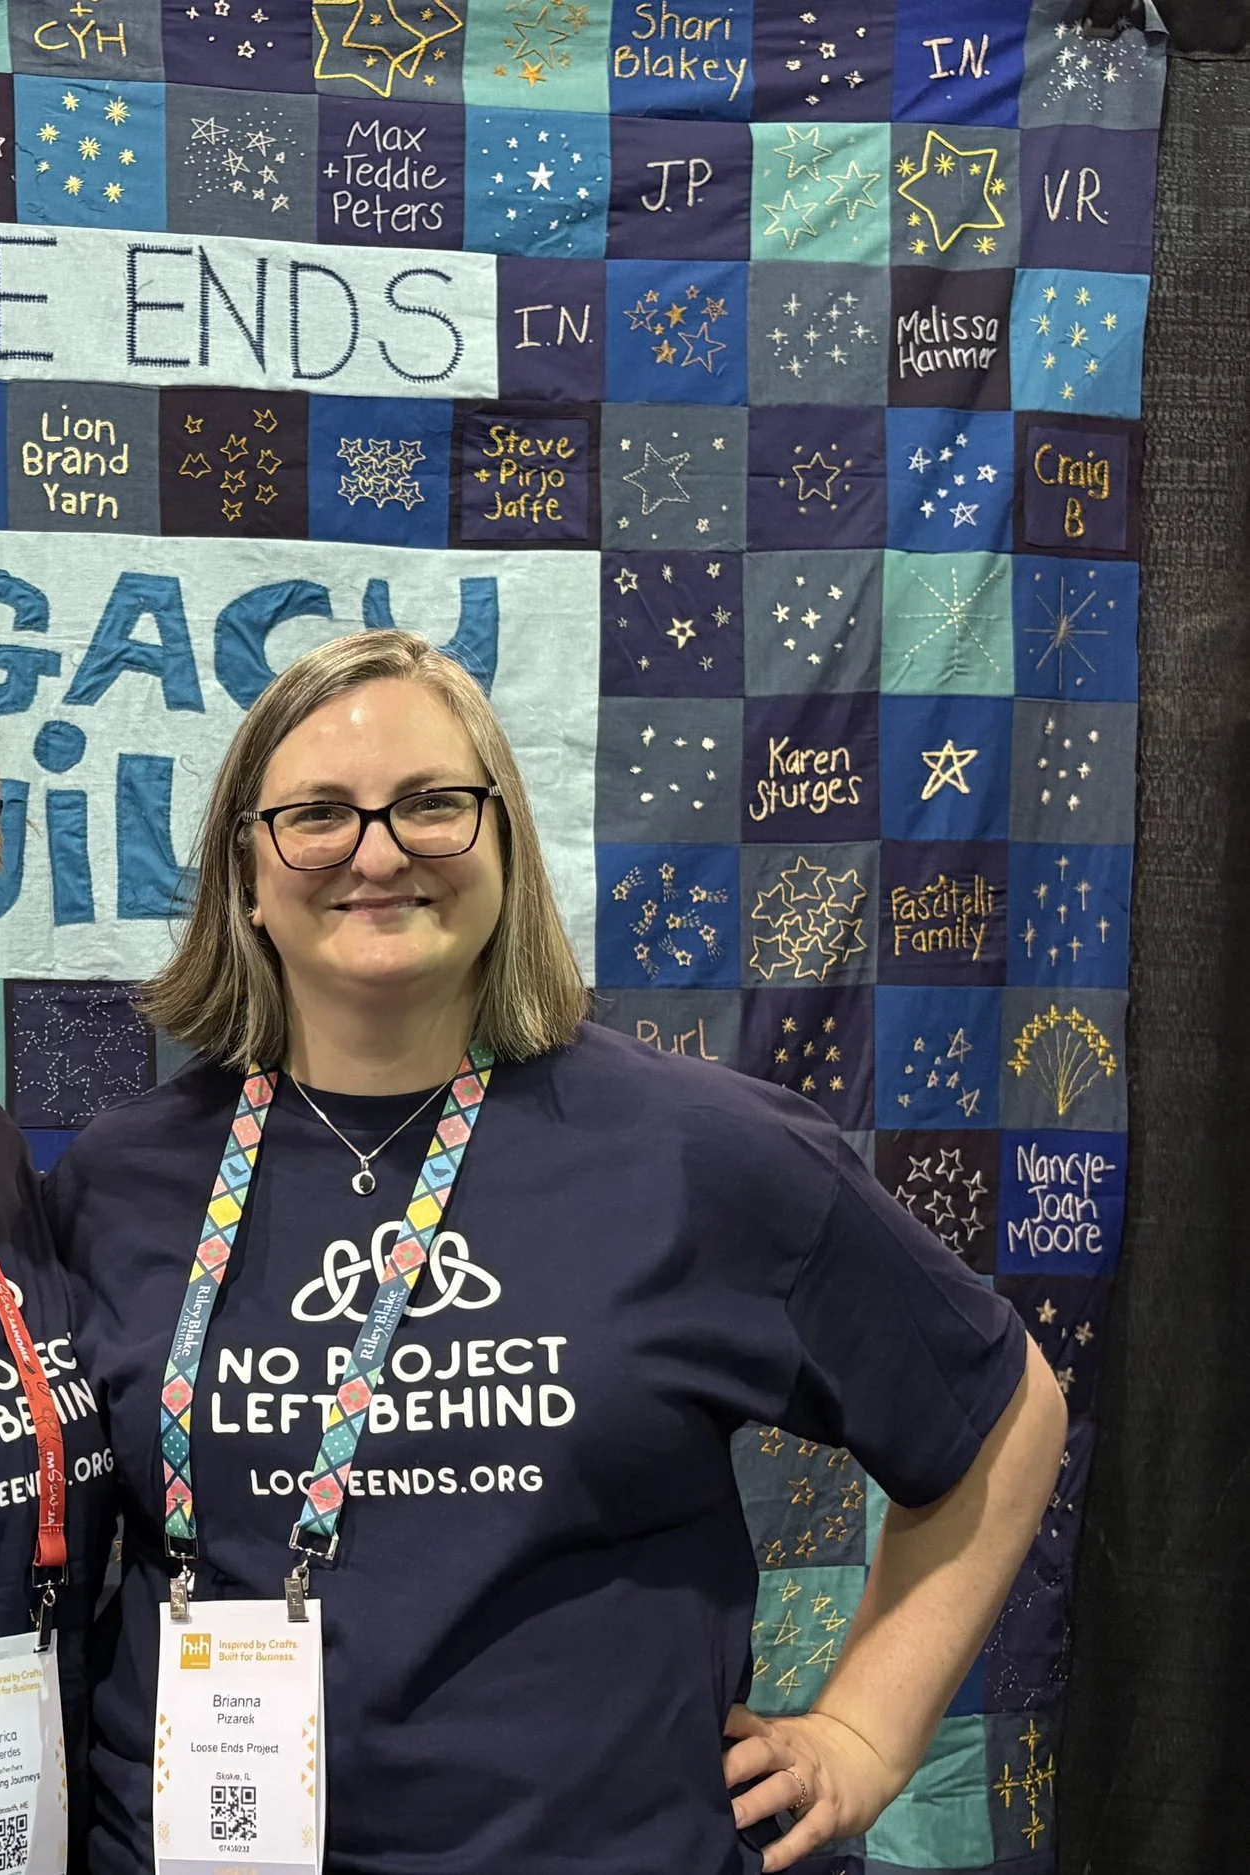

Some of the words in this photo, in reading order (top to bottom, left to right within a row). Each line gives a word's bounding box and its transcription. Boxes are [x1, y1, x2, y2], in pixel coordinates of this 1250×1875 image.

[33, 19, 127, 60] CYH
[635, 2, 731, 42] Shari
[613, 45, 747, 101] Blakey
[922, 35, 991, 79] I.N.
[346, 121, 428, 154] Max
[331, 191, 444, 232] Peters
[1043, 168, 1109, 224] V.R.
[125, 242, 465, 383] ENDS
[513, 304, 593, 349] I.N.
[897, 311, 1000, 345] Melissa
[41, 403, 117, 445] Lion
[483, 425, 575, 459] Steve
[21, 439, 130, 477] Brand
[499, 458, 565, 498] Pirjo
[1034, 443, 1111, 500] Craig
[43, 482, 120, 520] Yarn
[1064, 498, 1085, 538] B
[767, 736, 851, 778] Karen
[748, 772, 862, 822] Sturges
[894, 913, 986, 961] Family
[1016, 1142, 1116, 1189] Nancye-
[1027, 1185, 1097, 1225] Joan
[1008, 1222, 1102, 1258] Moore
[186, 1285, 211, 1318] Riley
[7, 1315, 31, 1362] JANOME
[182, 1320, 202, 1356] Blake
[360, 1324, 388, 1360] Riley
[374, 1290, 398, 1324] Blake
[217, 1347, 300, 1385] NO
[327, 1336, 568, 1385] POJECT
[369, 1384, 576, 1434] BEHIND
[251, 1464, 543, 1496] LOOEENDS.ORG
[219, 1640, 254, 1651] Inspired
[256, 1640, 266, 1651] by
[269, 1639, 299, 1649] Crafts.
[219, 1652, 238, 1661] Built
[241, 1652, 253, 1661] for
[256, 1652, 296, 1661] Business.
[213, 1694, 261, 1708] Brianna
[217, 1713, 255, 1724] Pizarek
[190, 1742, 218, 1753] Loose
[220, 1743, 244, 1753] Ends
[247, 1743, 279, 1755] Project
[10, 1773, 41, 1786] Journeys
